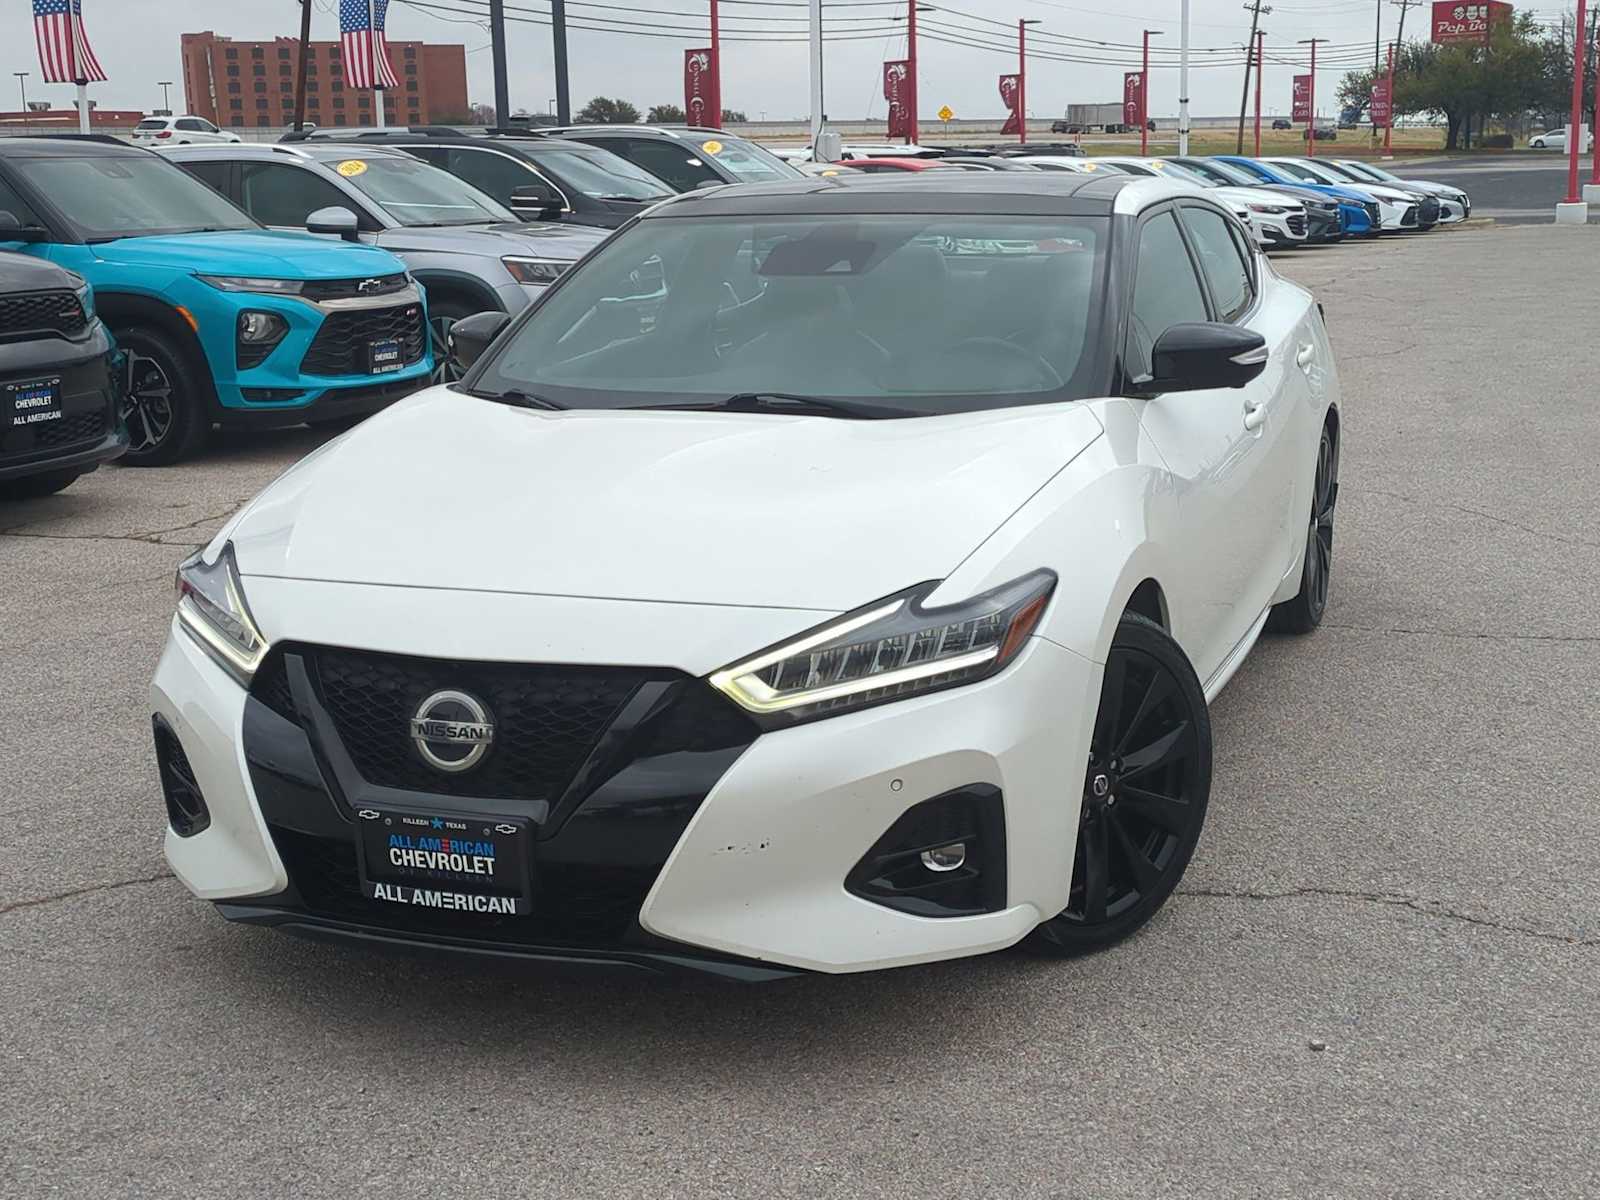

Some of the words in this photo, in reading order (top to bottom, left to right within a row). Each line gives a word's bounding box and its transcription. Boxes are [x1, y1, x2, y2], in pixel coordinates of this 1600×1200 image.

[1437, 21, 1465, 34] Pep
[15, 396, 52, 409] CHEVROLET
[13, 416, 26, 425] ALL
[27, 411, 61, 423] AMERICAN
[418, 722, 483, 739] NISSAN
[445, 821, 467, 830] TEXAS
[389, 834, 415, 849] ALL
[419, 837, 494, 856] AMERICAN
[389, 847, 495, 875] CHEVROLET
[374, 883, 408, 903] ALL
[412, 889, 517, 914] AMERICAN
